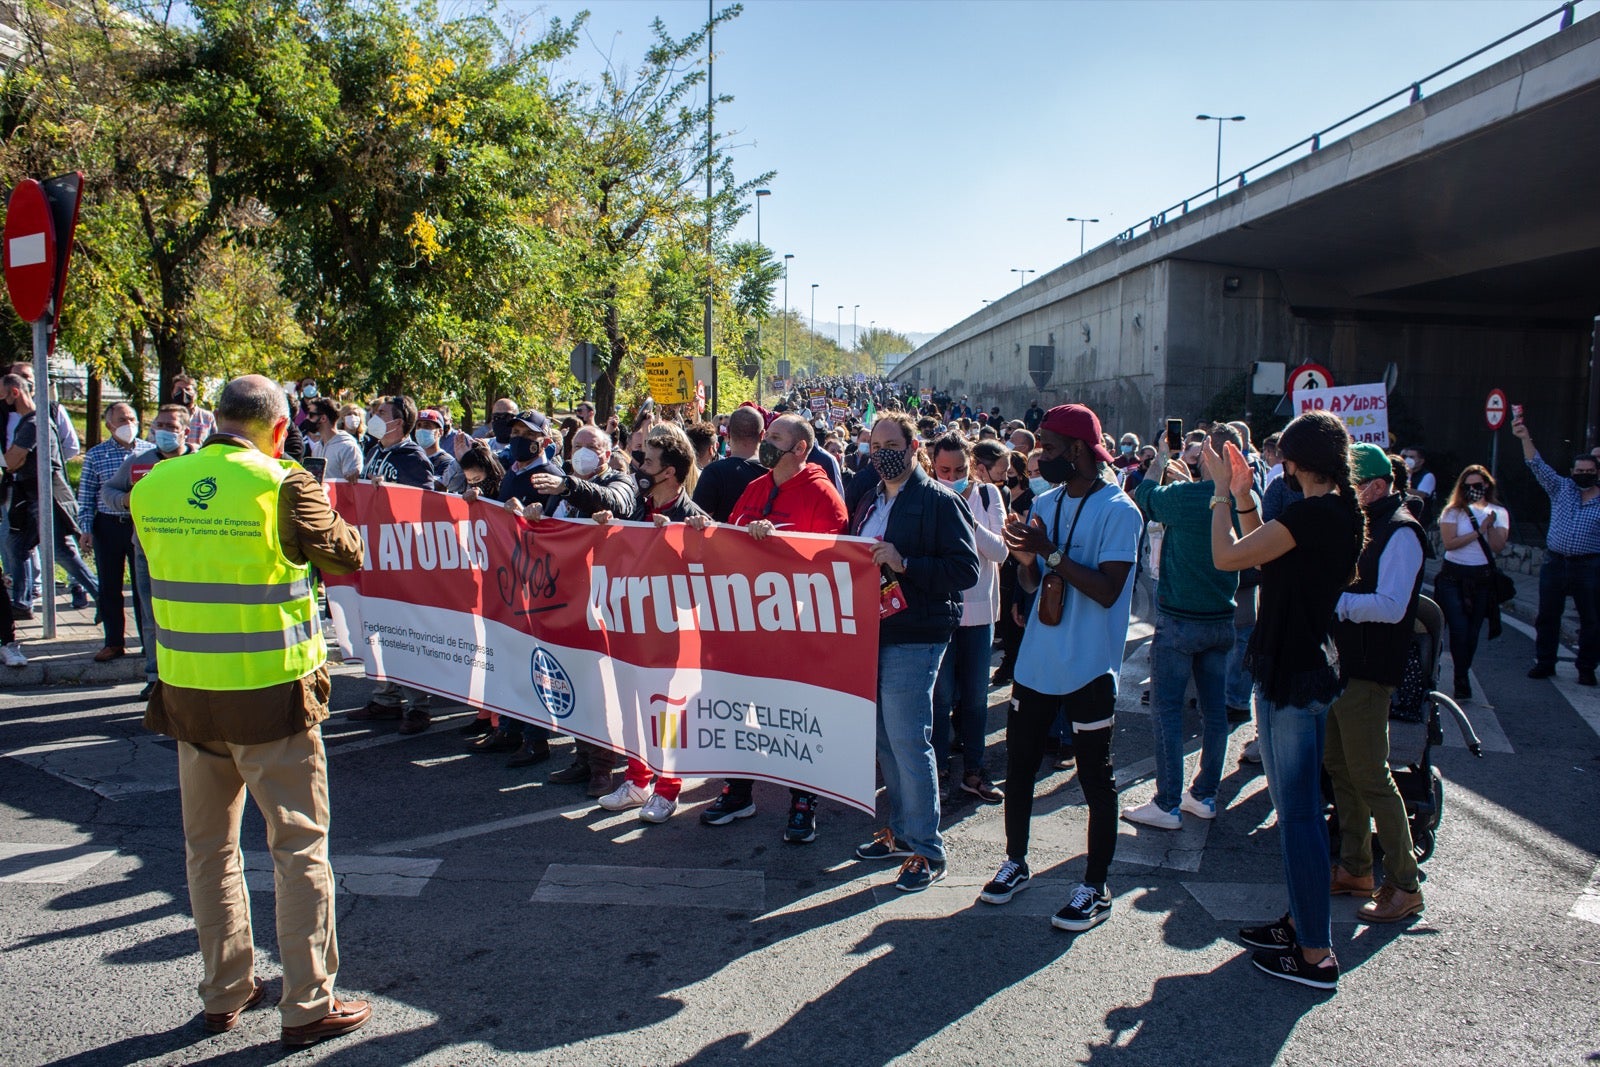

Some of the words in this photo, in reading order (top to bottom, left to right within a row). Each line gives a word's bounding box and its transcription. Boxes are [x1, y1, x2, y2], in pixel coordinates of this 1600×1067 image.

[1301, 397, 1324, 412] NO
[1330, 393, 1386, 412] AYUDAS
[141, 515, 177, 524] Federación
[179, 516, 212, 525] Provincial
[224, 518, 261, 527] Empresas
[184, 528, 189, 536] y
[191, 528, 218, 536] Turismo
[230, 529, 262, 537] Granada
[378, 519, 489, 571] AYUDAS
[497, 530, 560, 607] Nos
[586, 561, 857, 635] Arruinan!
[363, 621, 408, 637] Federación
[408, 628, 445, 645] Provincial
[446, 636, 457, 647] de
[458, 638, 494, 657] Empresas
[365, 636, 375, 646] de
[378, 635, 415, 653] Hostelería
[416, 645, 421, 656] y
[421, 644, 452, 661] Turismo
[452, 652, 463, 664] de
[463, 655, 495, 672] Granada
[697, 698, 823, 738] HOSTELERÍA
[698, 728, 726, 749] DE
[735, 730, 813, 764] ESPAÑA
